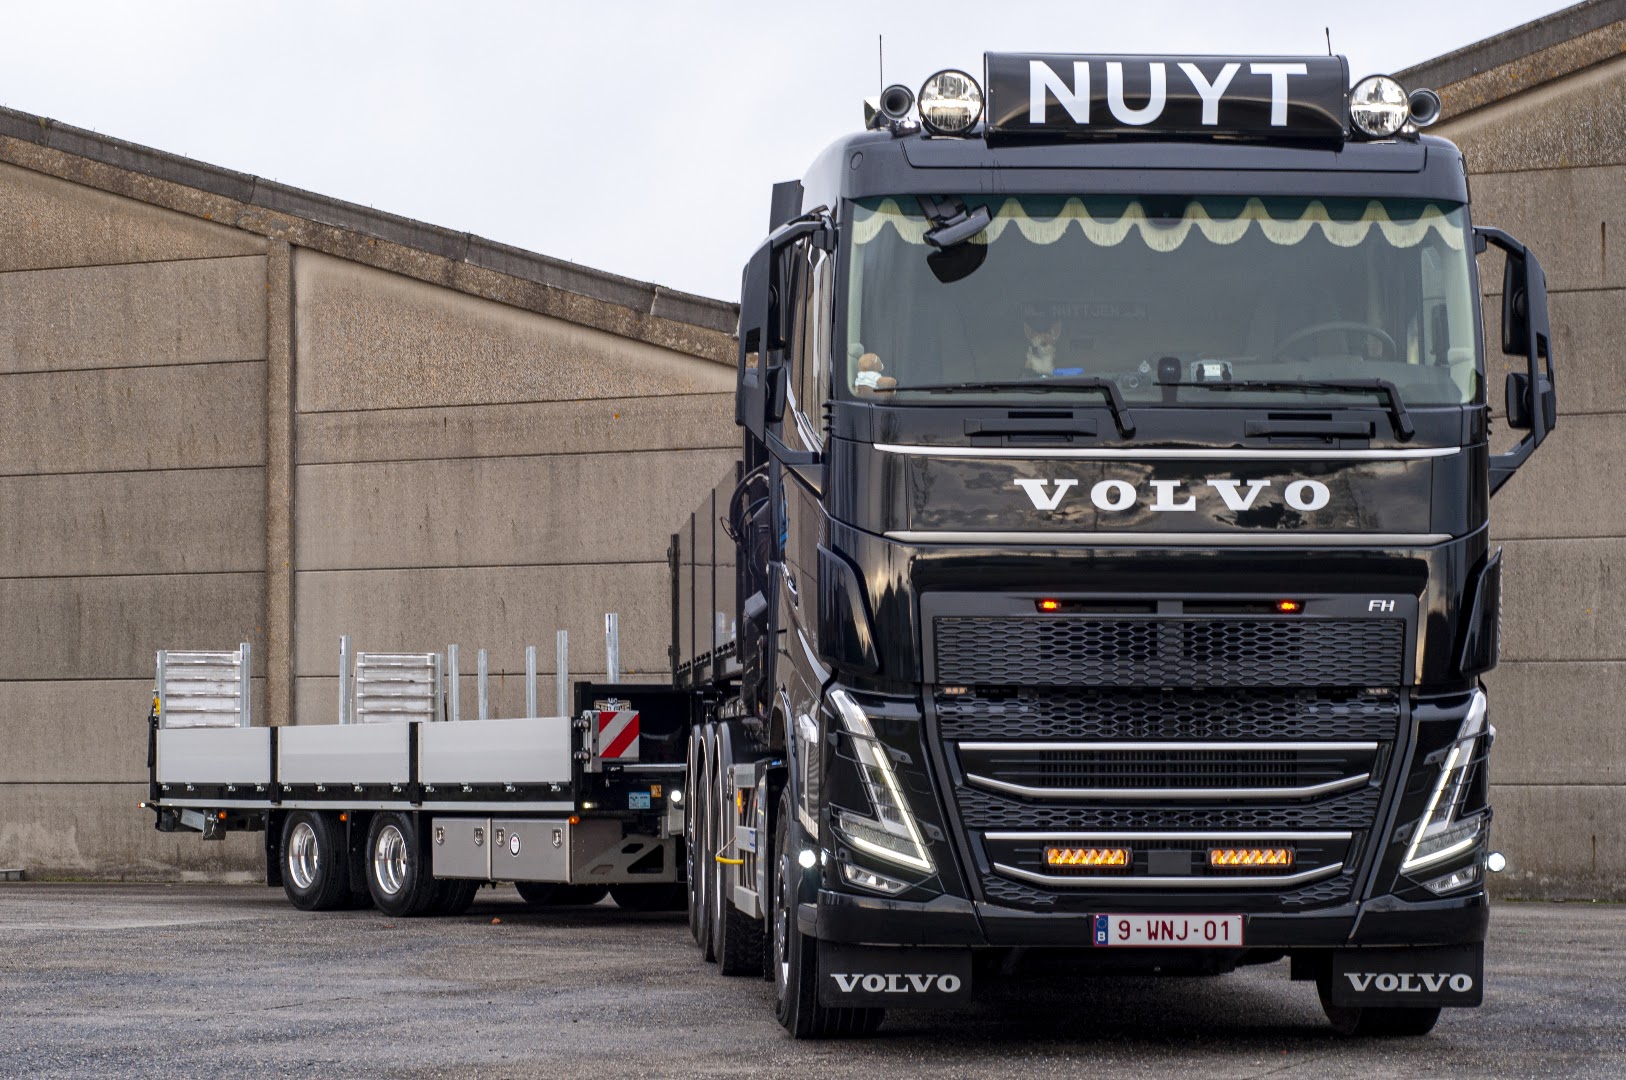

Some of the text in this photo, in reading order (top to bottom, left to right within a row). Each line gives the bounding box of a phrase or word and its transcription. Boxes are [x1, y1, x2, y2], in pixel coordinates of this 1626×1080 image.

[1029, 60, 1308, 126] NUYT
[1013, 478, 1331, 512] VOLVO
[1368, 599, 1396, 612] FH
[1097, 931, 1106, 942] B
[1118, 919, 1229, 941] 9-WNJ-01
[830, 973, 961, 993] VOLVO
[1344, 972, 1474, 993] VOLVO
